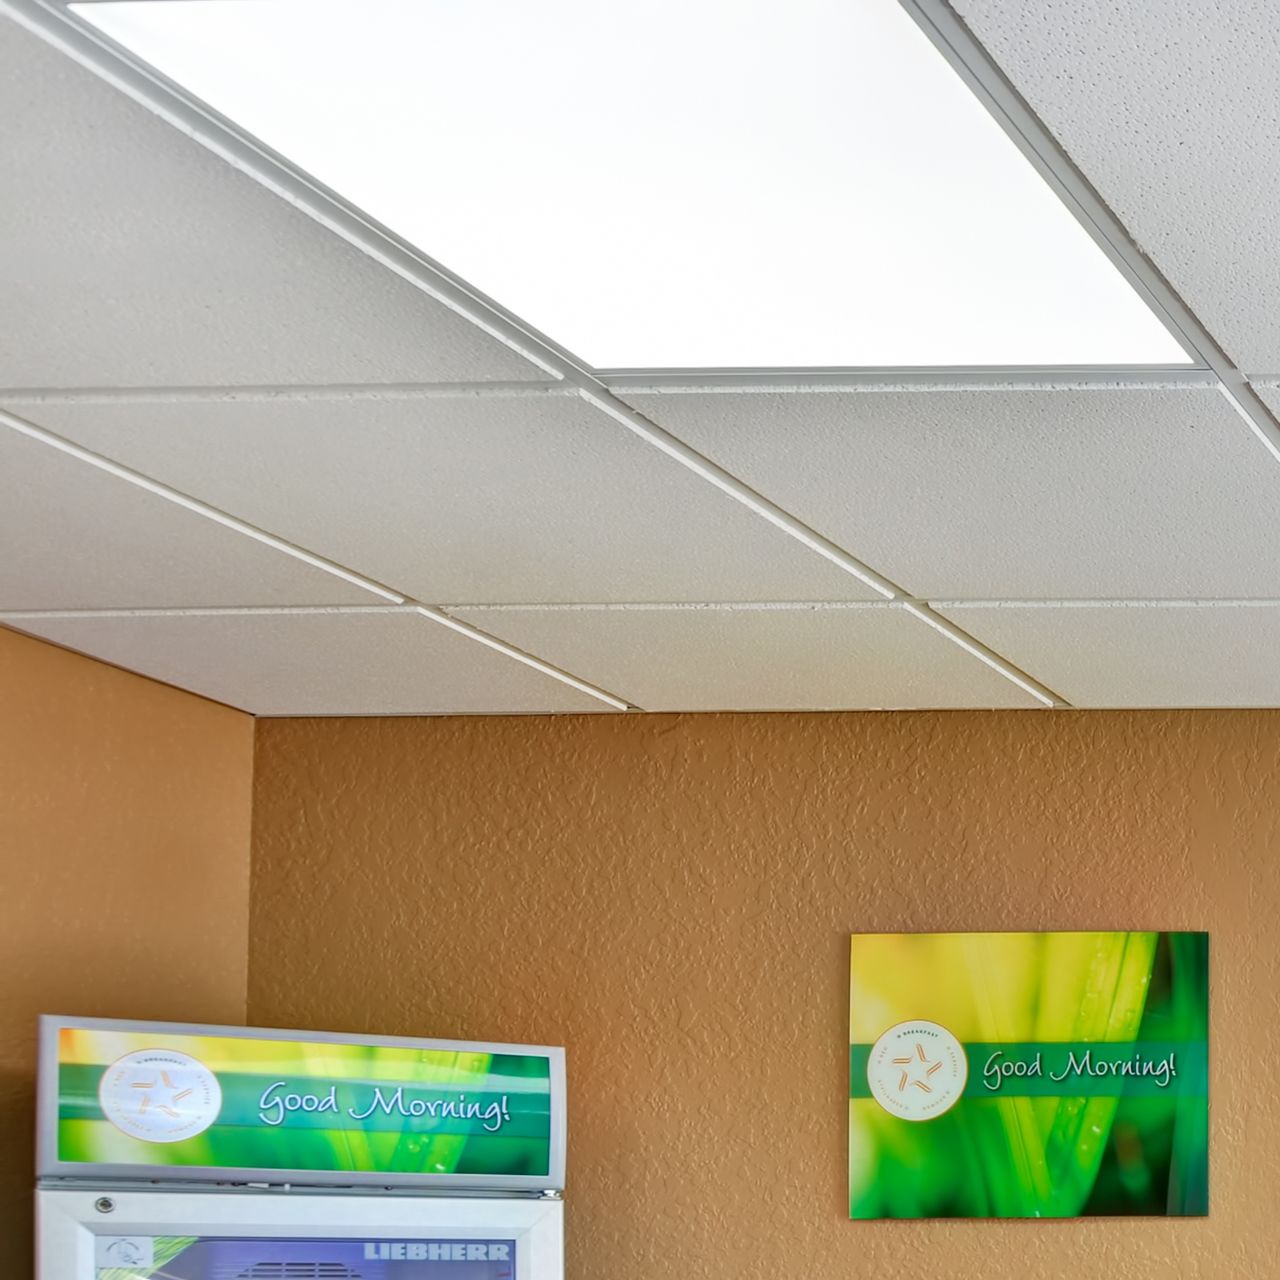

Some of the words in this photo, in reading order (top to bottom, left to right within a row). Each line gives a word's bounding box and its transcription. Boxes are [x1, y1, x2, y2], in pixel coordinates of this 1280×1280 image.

[983, 1050, 1043, 1091] Good
[1049, 1049, 1177, 1087] Morning!
[258, 1081, 339, 1126] Good
[348, 1086, 511, 1132] Morning!
[363, 1242, 510, 1261] LIEBHERR
